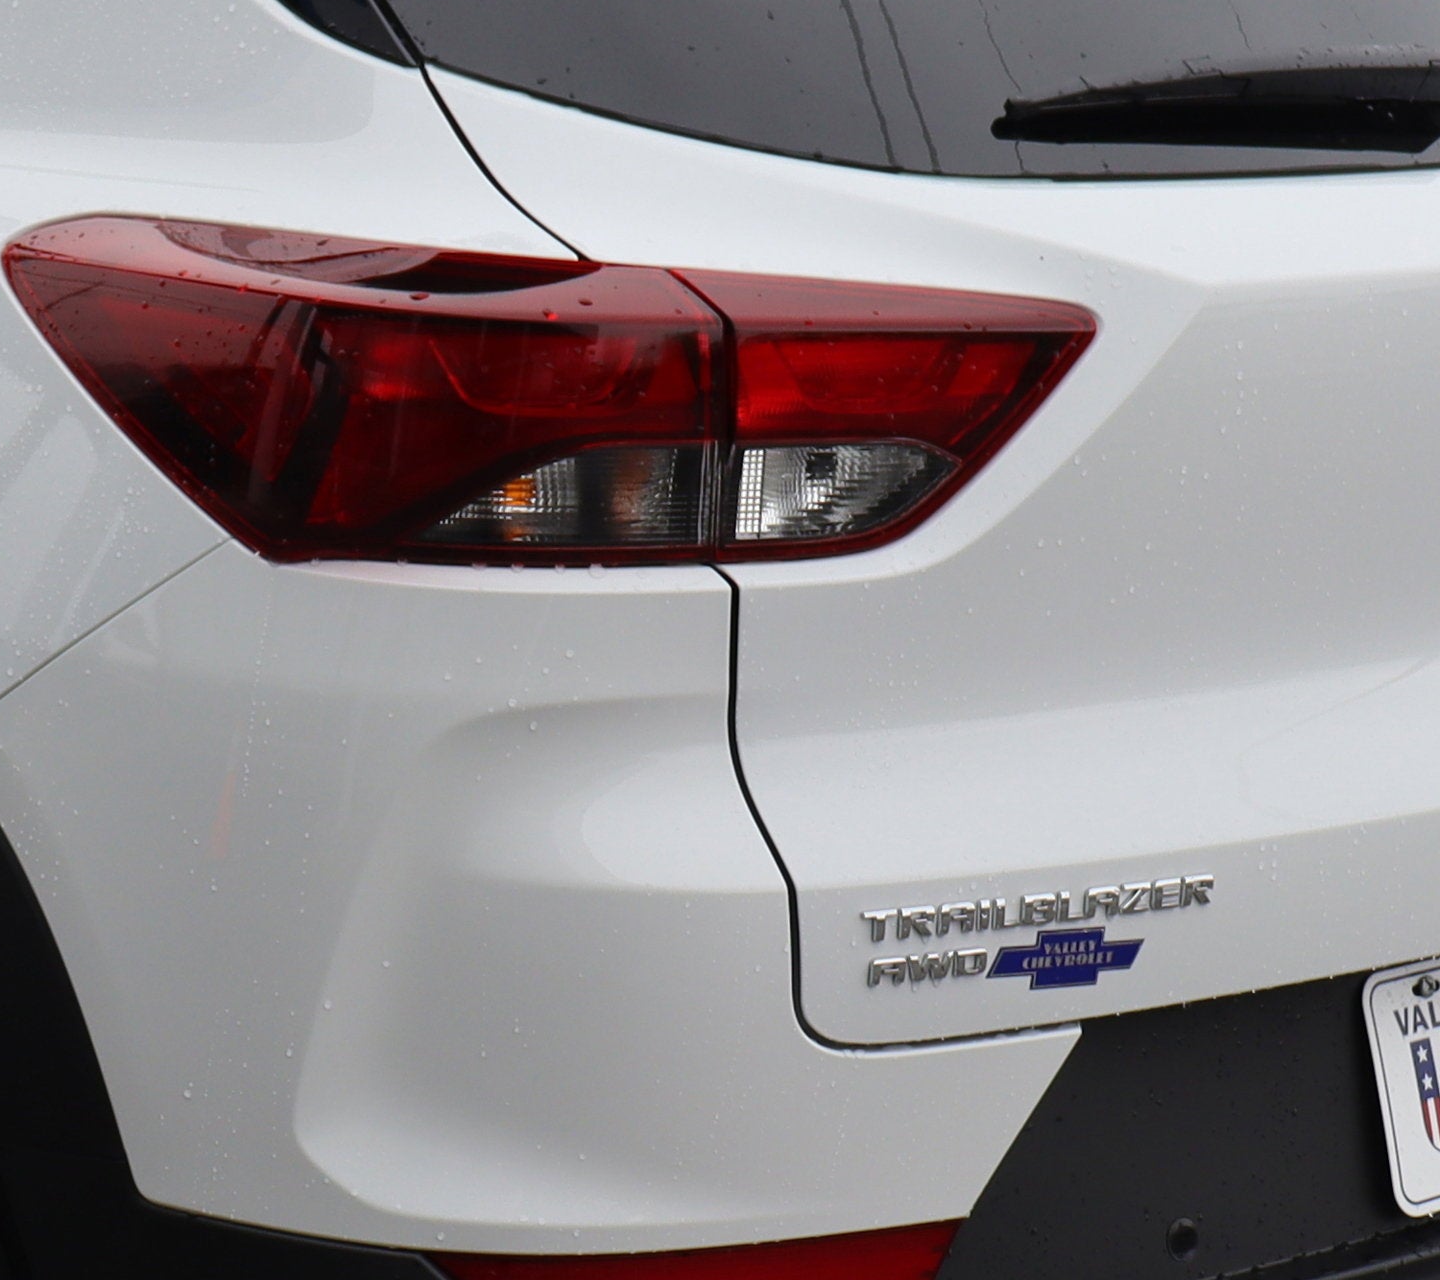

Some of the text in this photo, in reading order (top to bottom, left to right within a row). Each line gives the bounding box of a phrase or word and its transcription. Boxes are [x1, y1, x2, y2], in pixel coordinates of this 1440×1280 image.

[860, 873, 1216, 943] TRAILBLAZER
[1021, 950, 1114, 971] CHEVROLET
[1043, 939, 1097, 955] VALLEY
[866, 947, 988, 988] AWD
